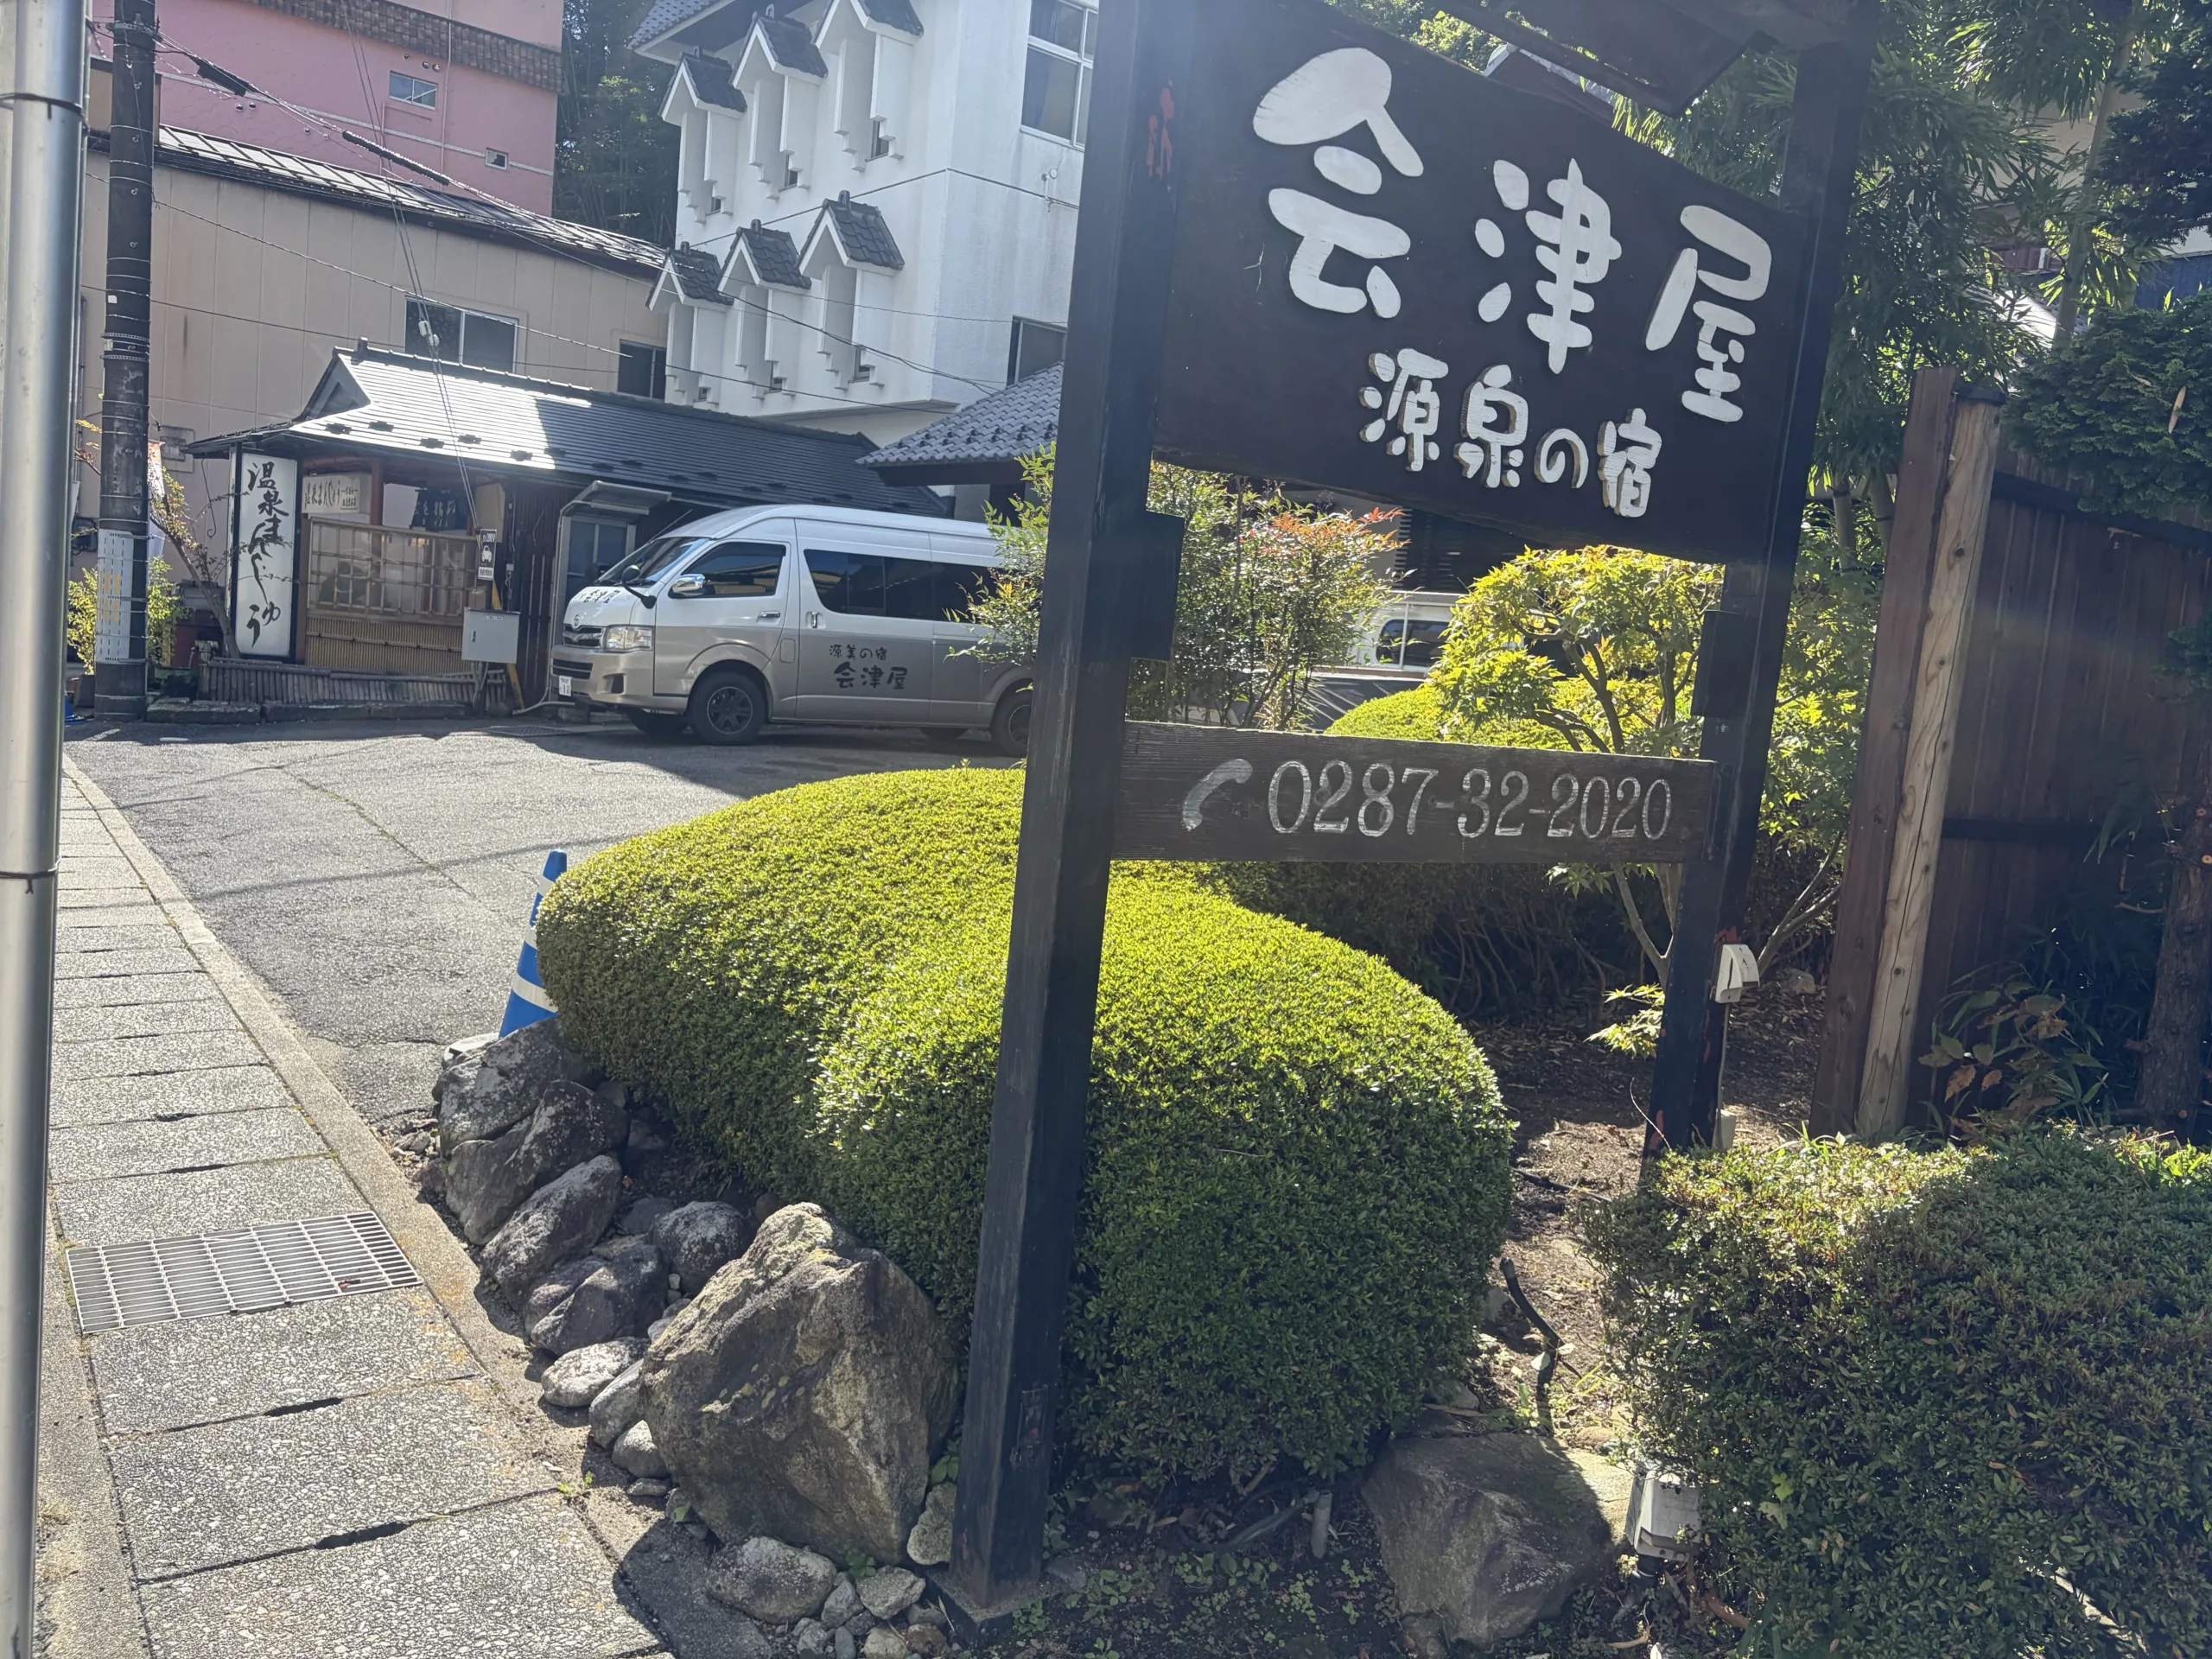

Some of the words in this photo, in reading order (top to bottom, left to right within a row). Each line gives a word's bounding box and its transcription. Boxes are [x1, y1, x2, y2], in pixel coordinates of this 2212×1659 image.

[1253, 48, 1772, 423] 会津屋
[1358, 347, 1662, 518] 源泉の宿
[246, 461, 289, 648] 温泉まんじゅう
[829, 644, 887, 661] 源美の宿
[834, 661, 908, 690] 会津屋
[1268, 759, 1673, 841] 0287-32-2020
